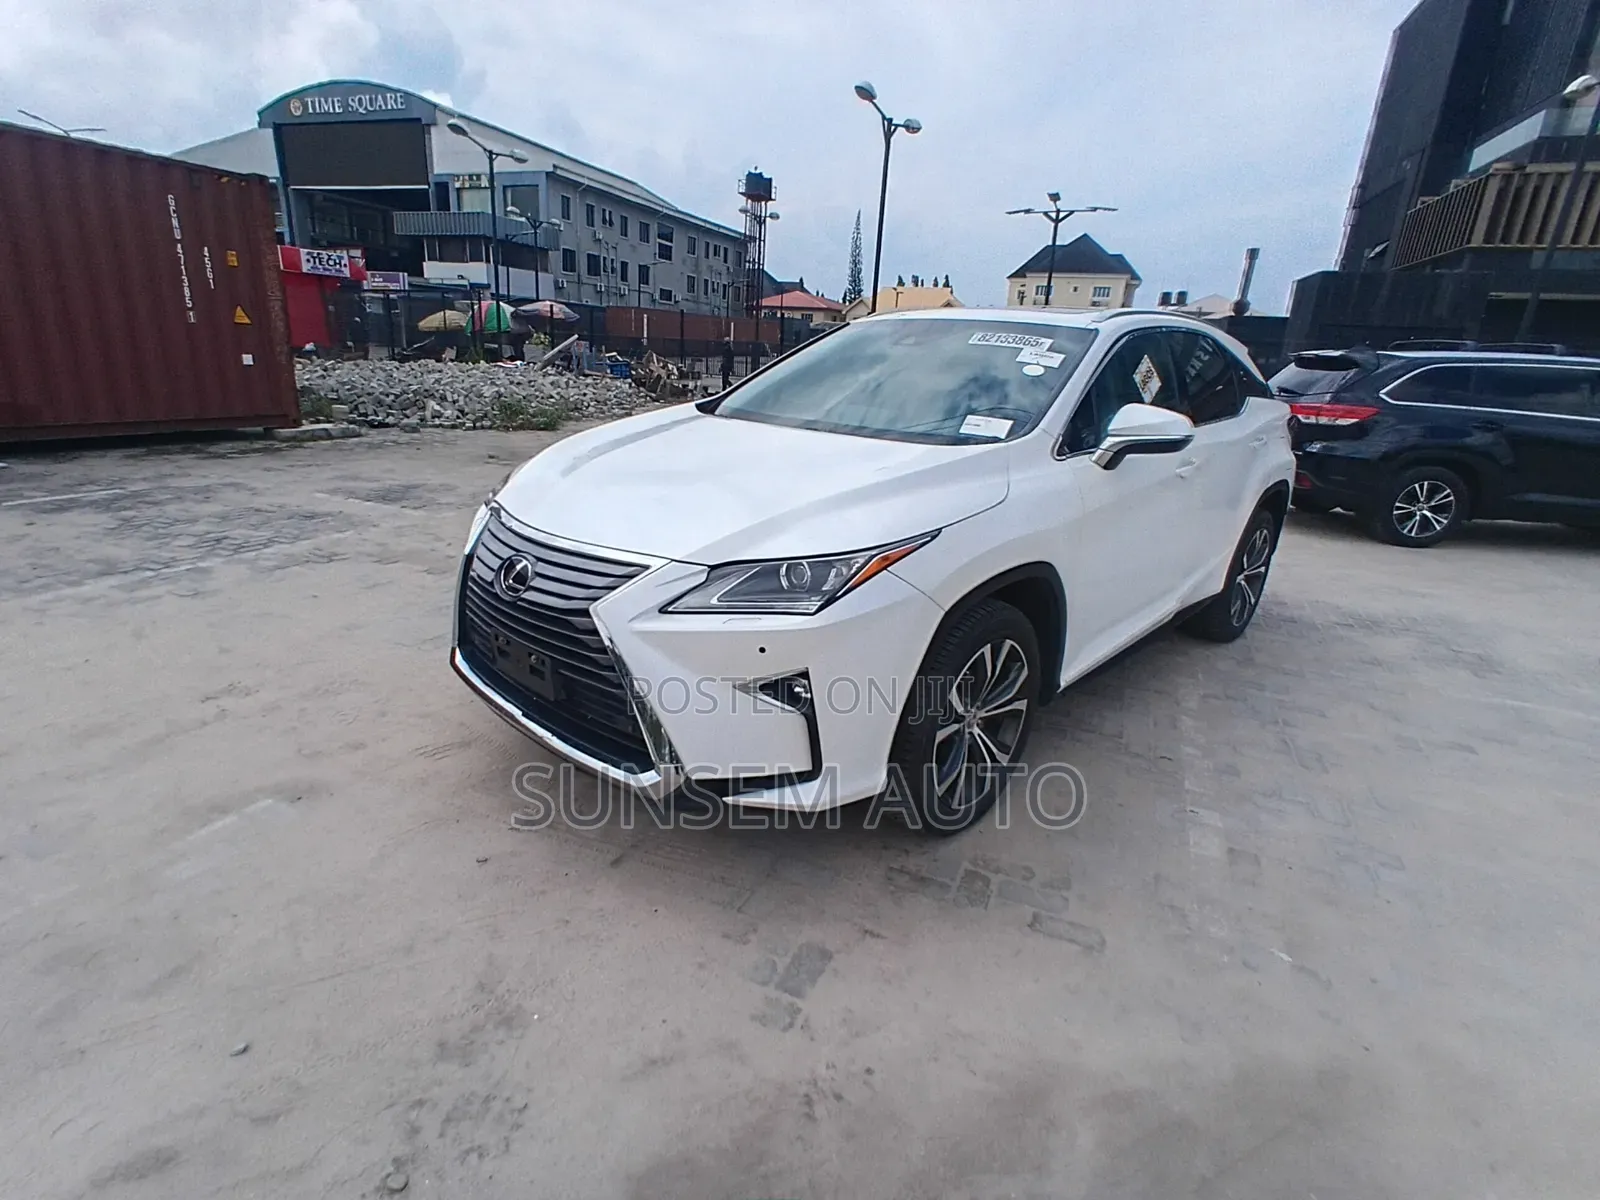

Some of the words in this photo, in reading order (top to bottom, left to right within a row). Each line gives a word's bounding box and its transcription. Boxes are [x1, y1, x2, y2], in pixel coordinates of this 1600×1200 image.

[305, 97, 343, 114] TIME
[348, 92, 406, 114] SQUARE
[311, 254, 342, 268] TECH
